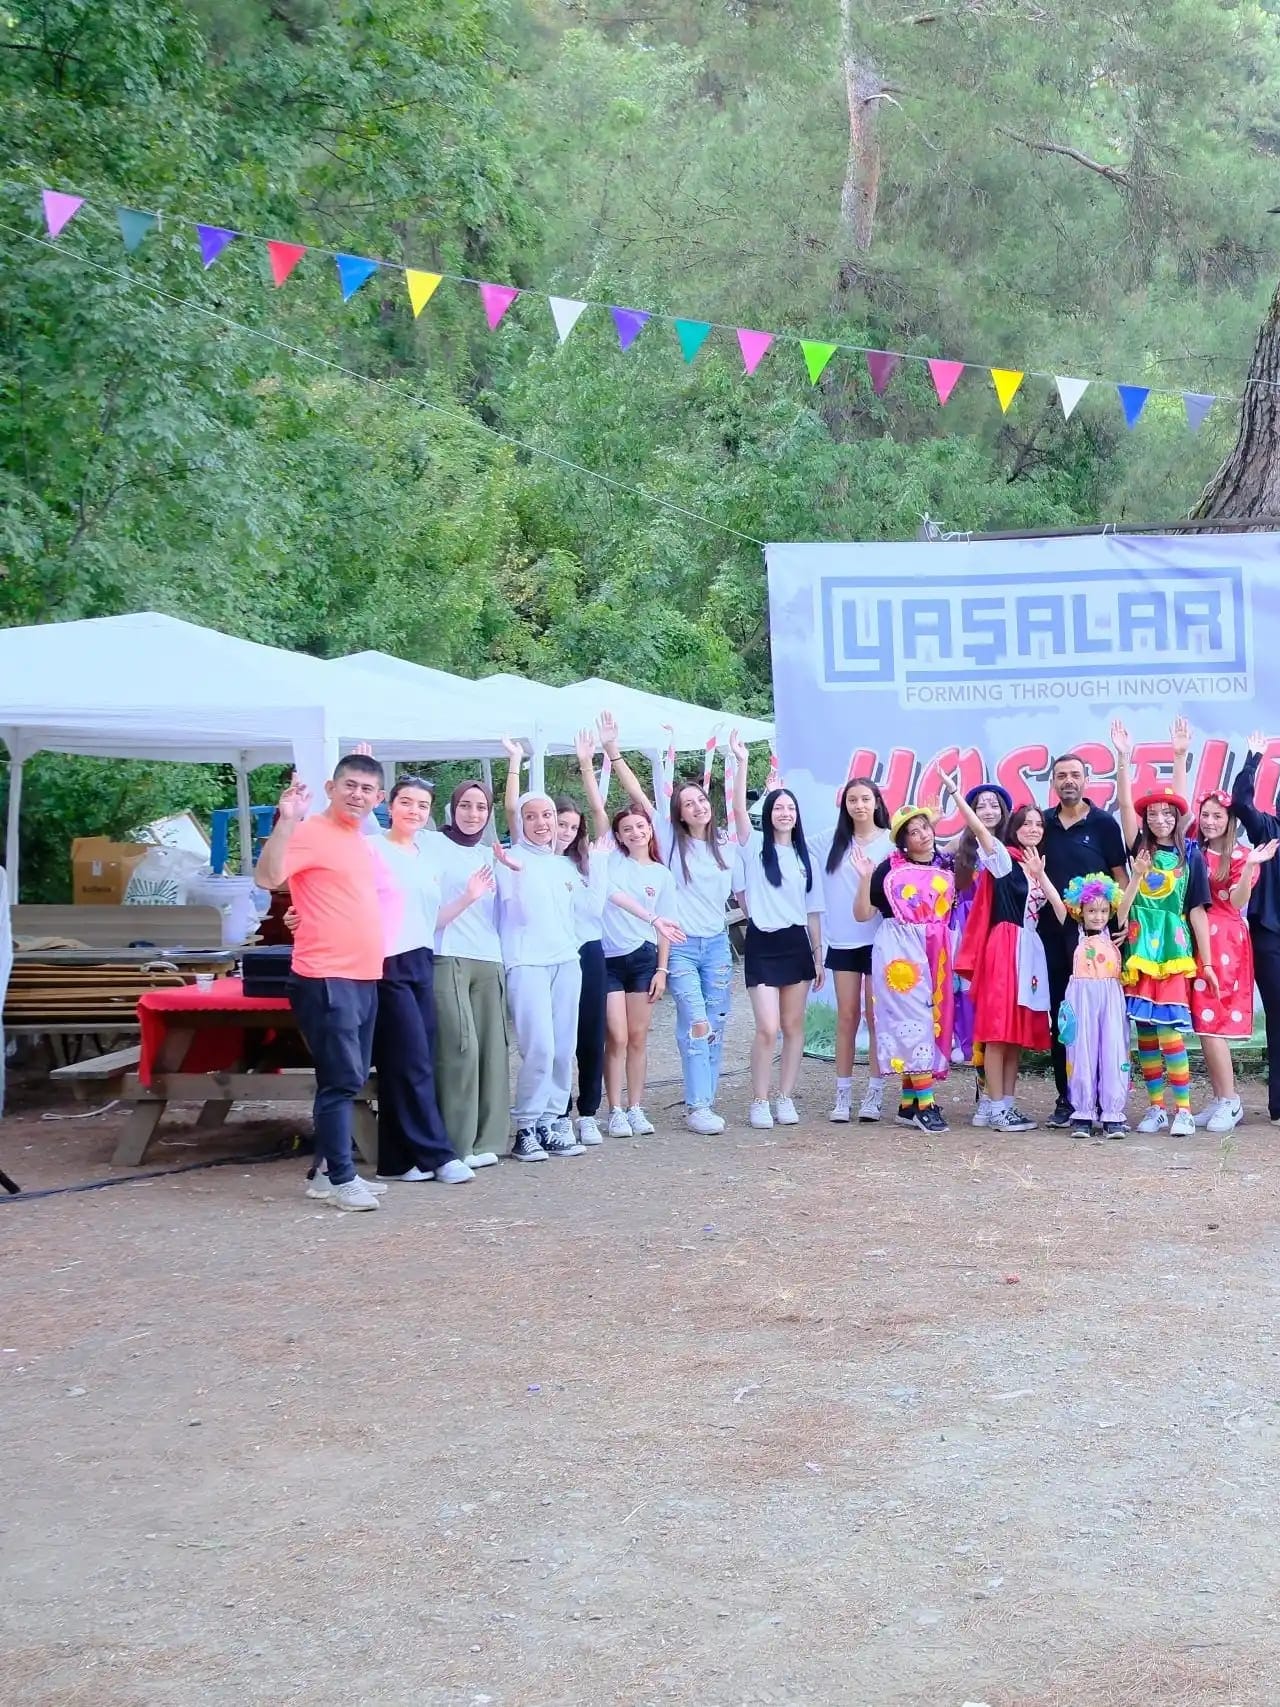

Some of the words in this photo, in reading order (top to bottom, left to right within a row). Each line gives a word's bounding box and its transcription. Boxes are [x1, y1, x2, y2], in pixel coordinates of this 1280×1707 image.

[905, 683, 1004, 704] FORMING
[1009, 679, 1110, 701] THROUGH
[1117, 675, 1249, 697] INNOVATION
